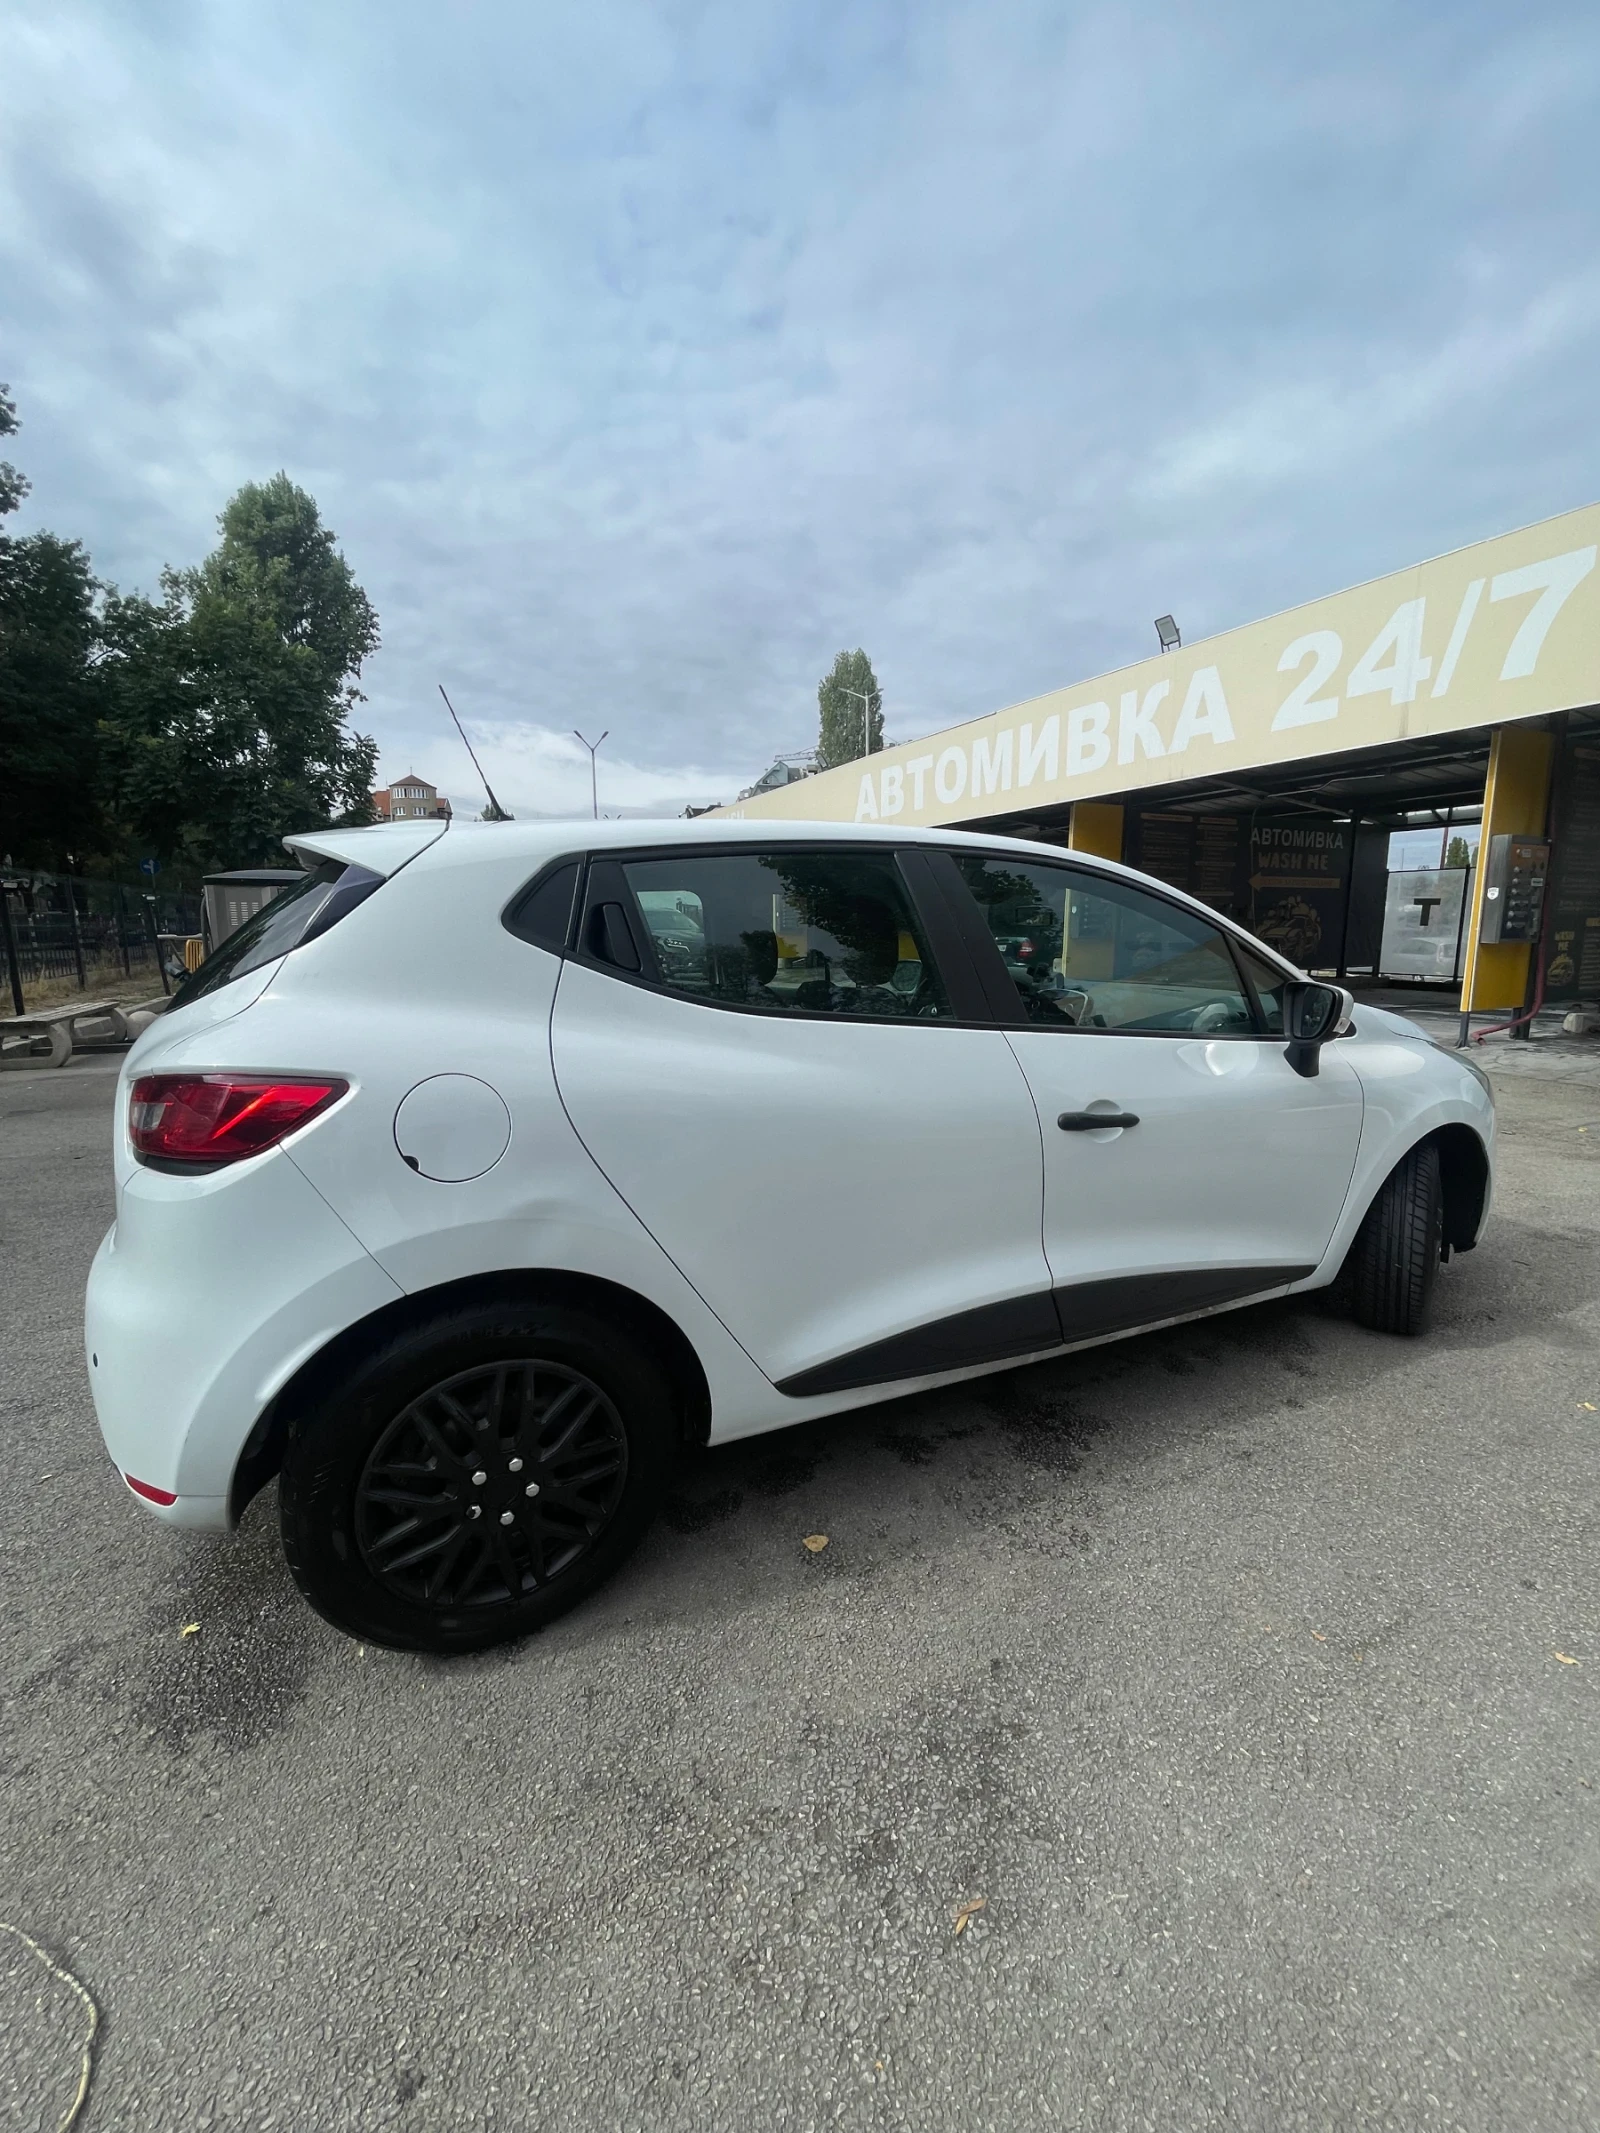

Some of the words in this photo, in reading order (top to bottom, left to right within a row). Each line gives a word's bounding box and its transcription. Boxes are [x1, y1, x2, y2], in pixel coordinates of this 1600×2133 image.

[854, 665, 1236, 822] АВТОМИВКА
[1271, 544, 1598, 732] 24/7
[1249, 827, 1344, 850] АВТОМИВКА
[1258, 852, 1303, 870] WASH
[1307, 853, 1329, 871] ME
